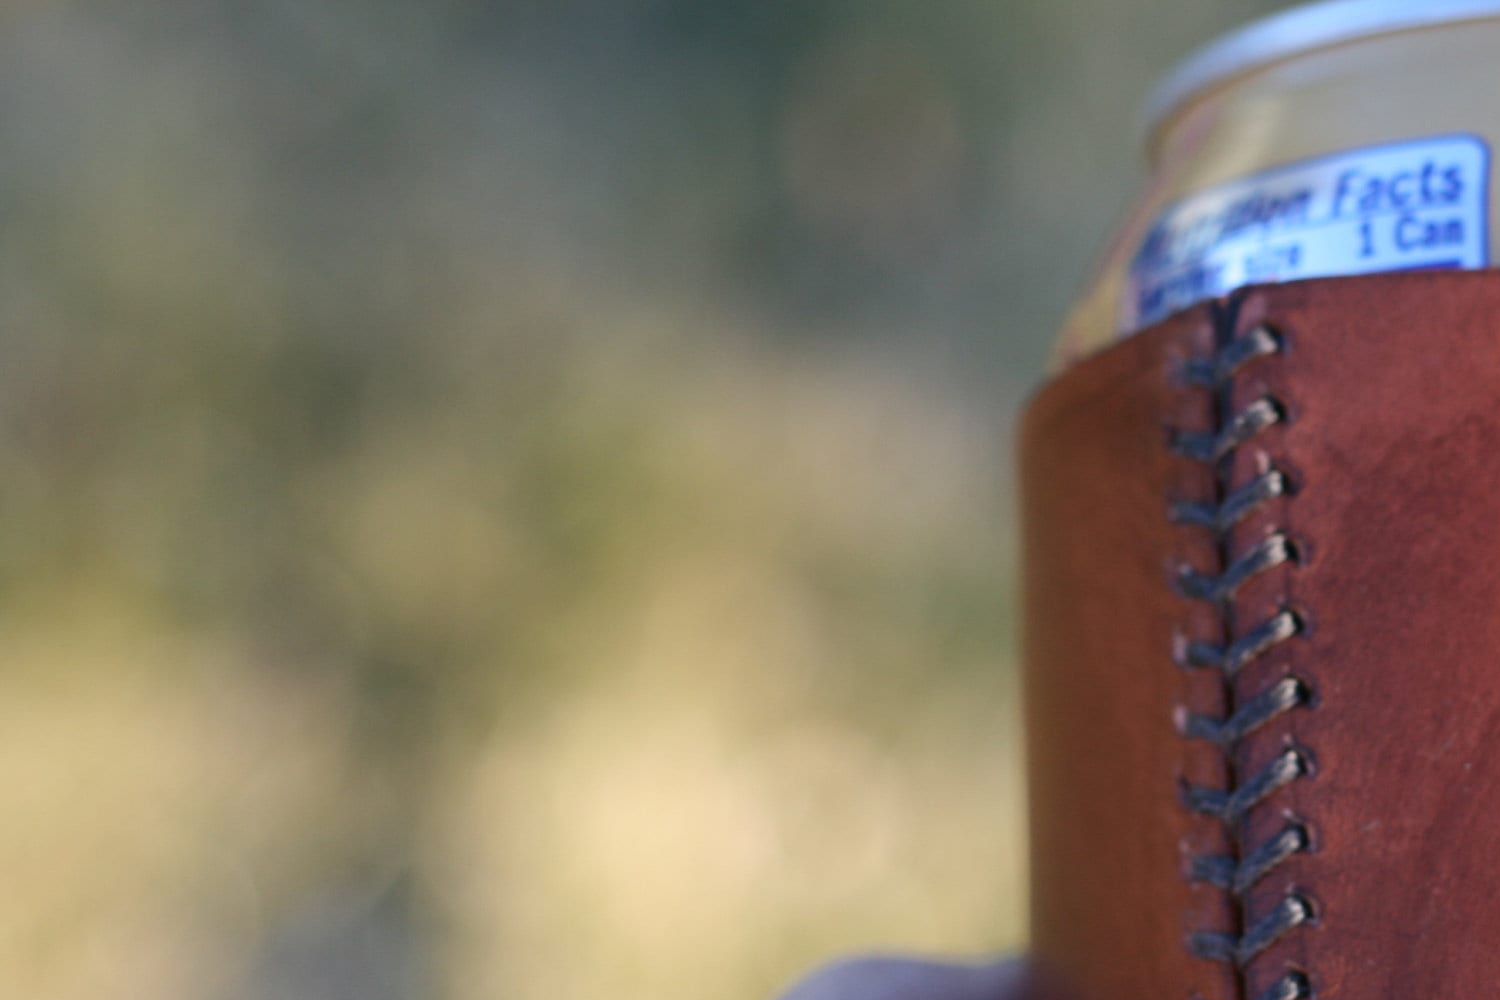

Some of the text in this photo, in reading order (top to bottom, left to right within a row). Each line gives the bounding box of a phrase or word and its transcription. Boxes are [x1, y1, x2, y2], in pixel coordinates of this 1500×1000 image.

[1334, 160, 1463, 218] Facts
[1356, 219, 1376, 260] 1
[1394, 216, 1463, 252] Can
